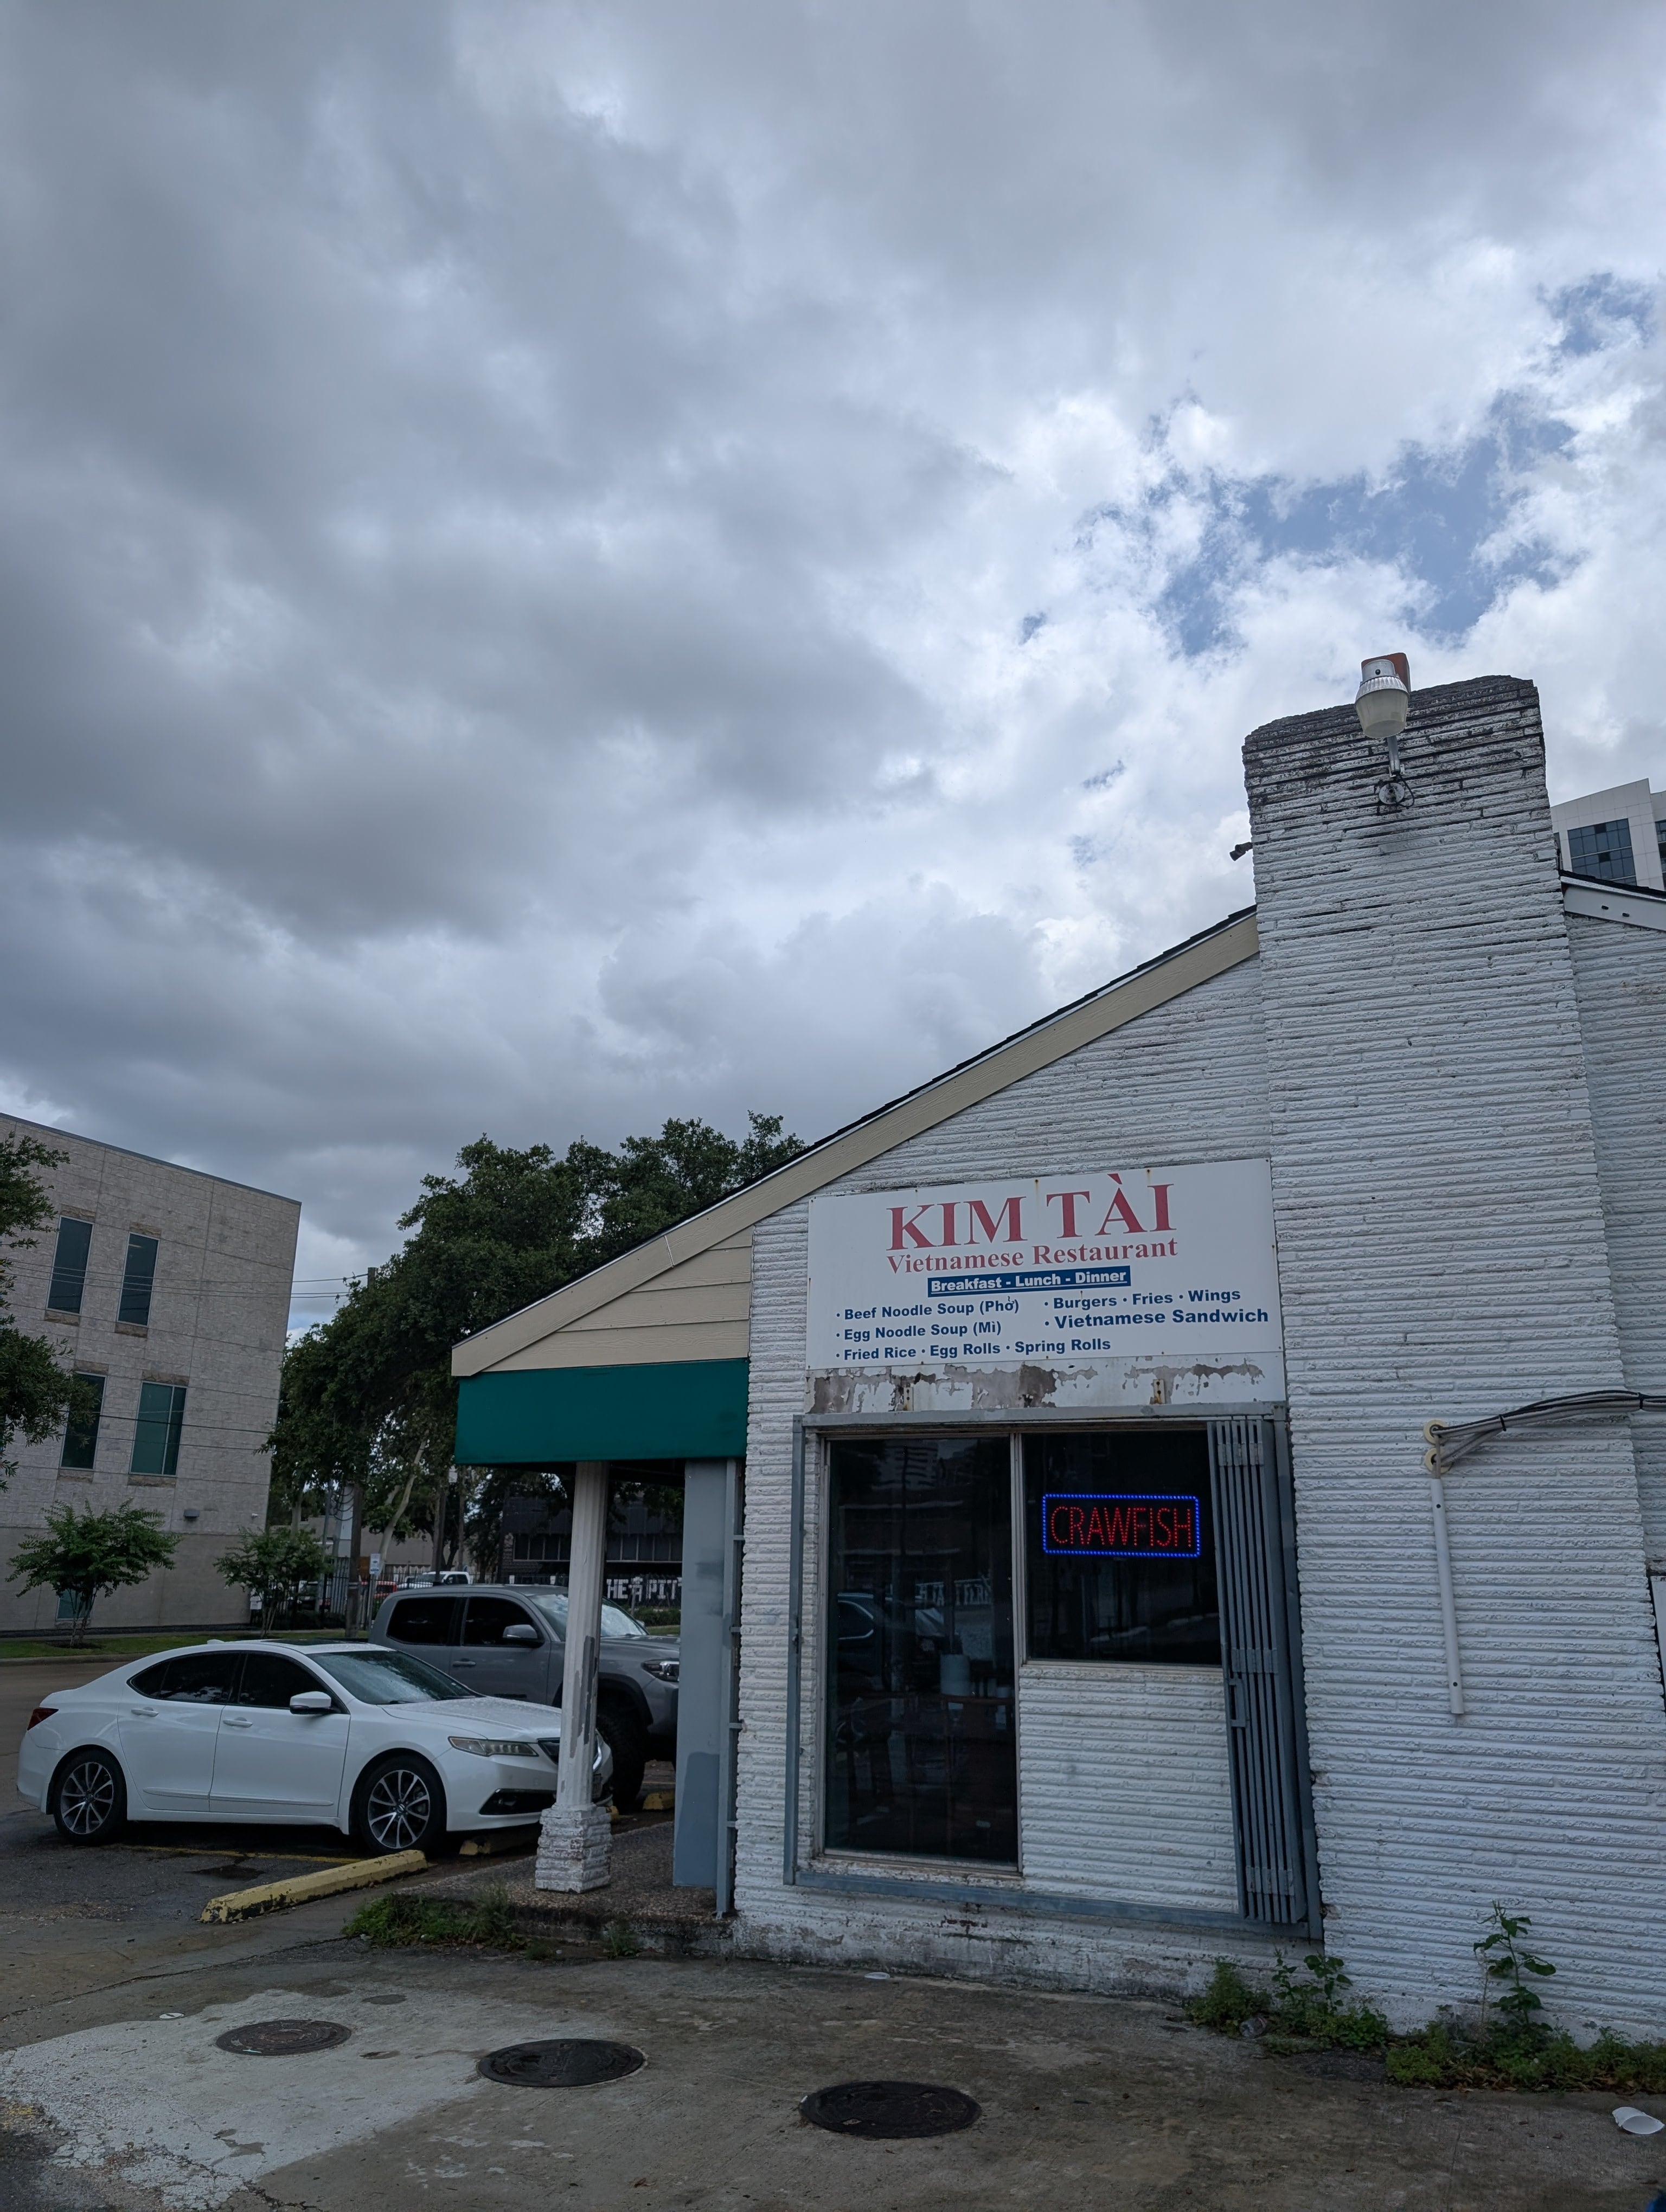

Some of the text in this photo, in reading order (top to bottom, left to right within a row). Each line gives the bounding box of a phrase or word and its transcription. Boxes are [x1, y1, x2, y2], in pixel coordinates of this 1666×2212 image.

[886, 1173, 1177, 1251] KIM TÀI
[887, 1238, 1178, 1274] Vietnamese Restaurant
[931, 1277, 1002, 1293] Breakfast
[1015, 1274, 1061, 1287] Lunch
[1075, 1270, 1127, 1285] Dinner
[844, 1296, 1020, 1320] Beef Noodle Soup (Phở)
[1053, 1289, 1241, 1311] Burgers Fries Wings
[1054, 1308, 1269, 1329] Vietnamese Sandwich
[844, 1321, 1002, 1342] Egg Noodle Soup (Mì)
[844, 1338, 1111, 1360] Fried Rice Egg Rolls Spring Rolls
[1050, 1506, 1192, 1547] CRAWFISH
